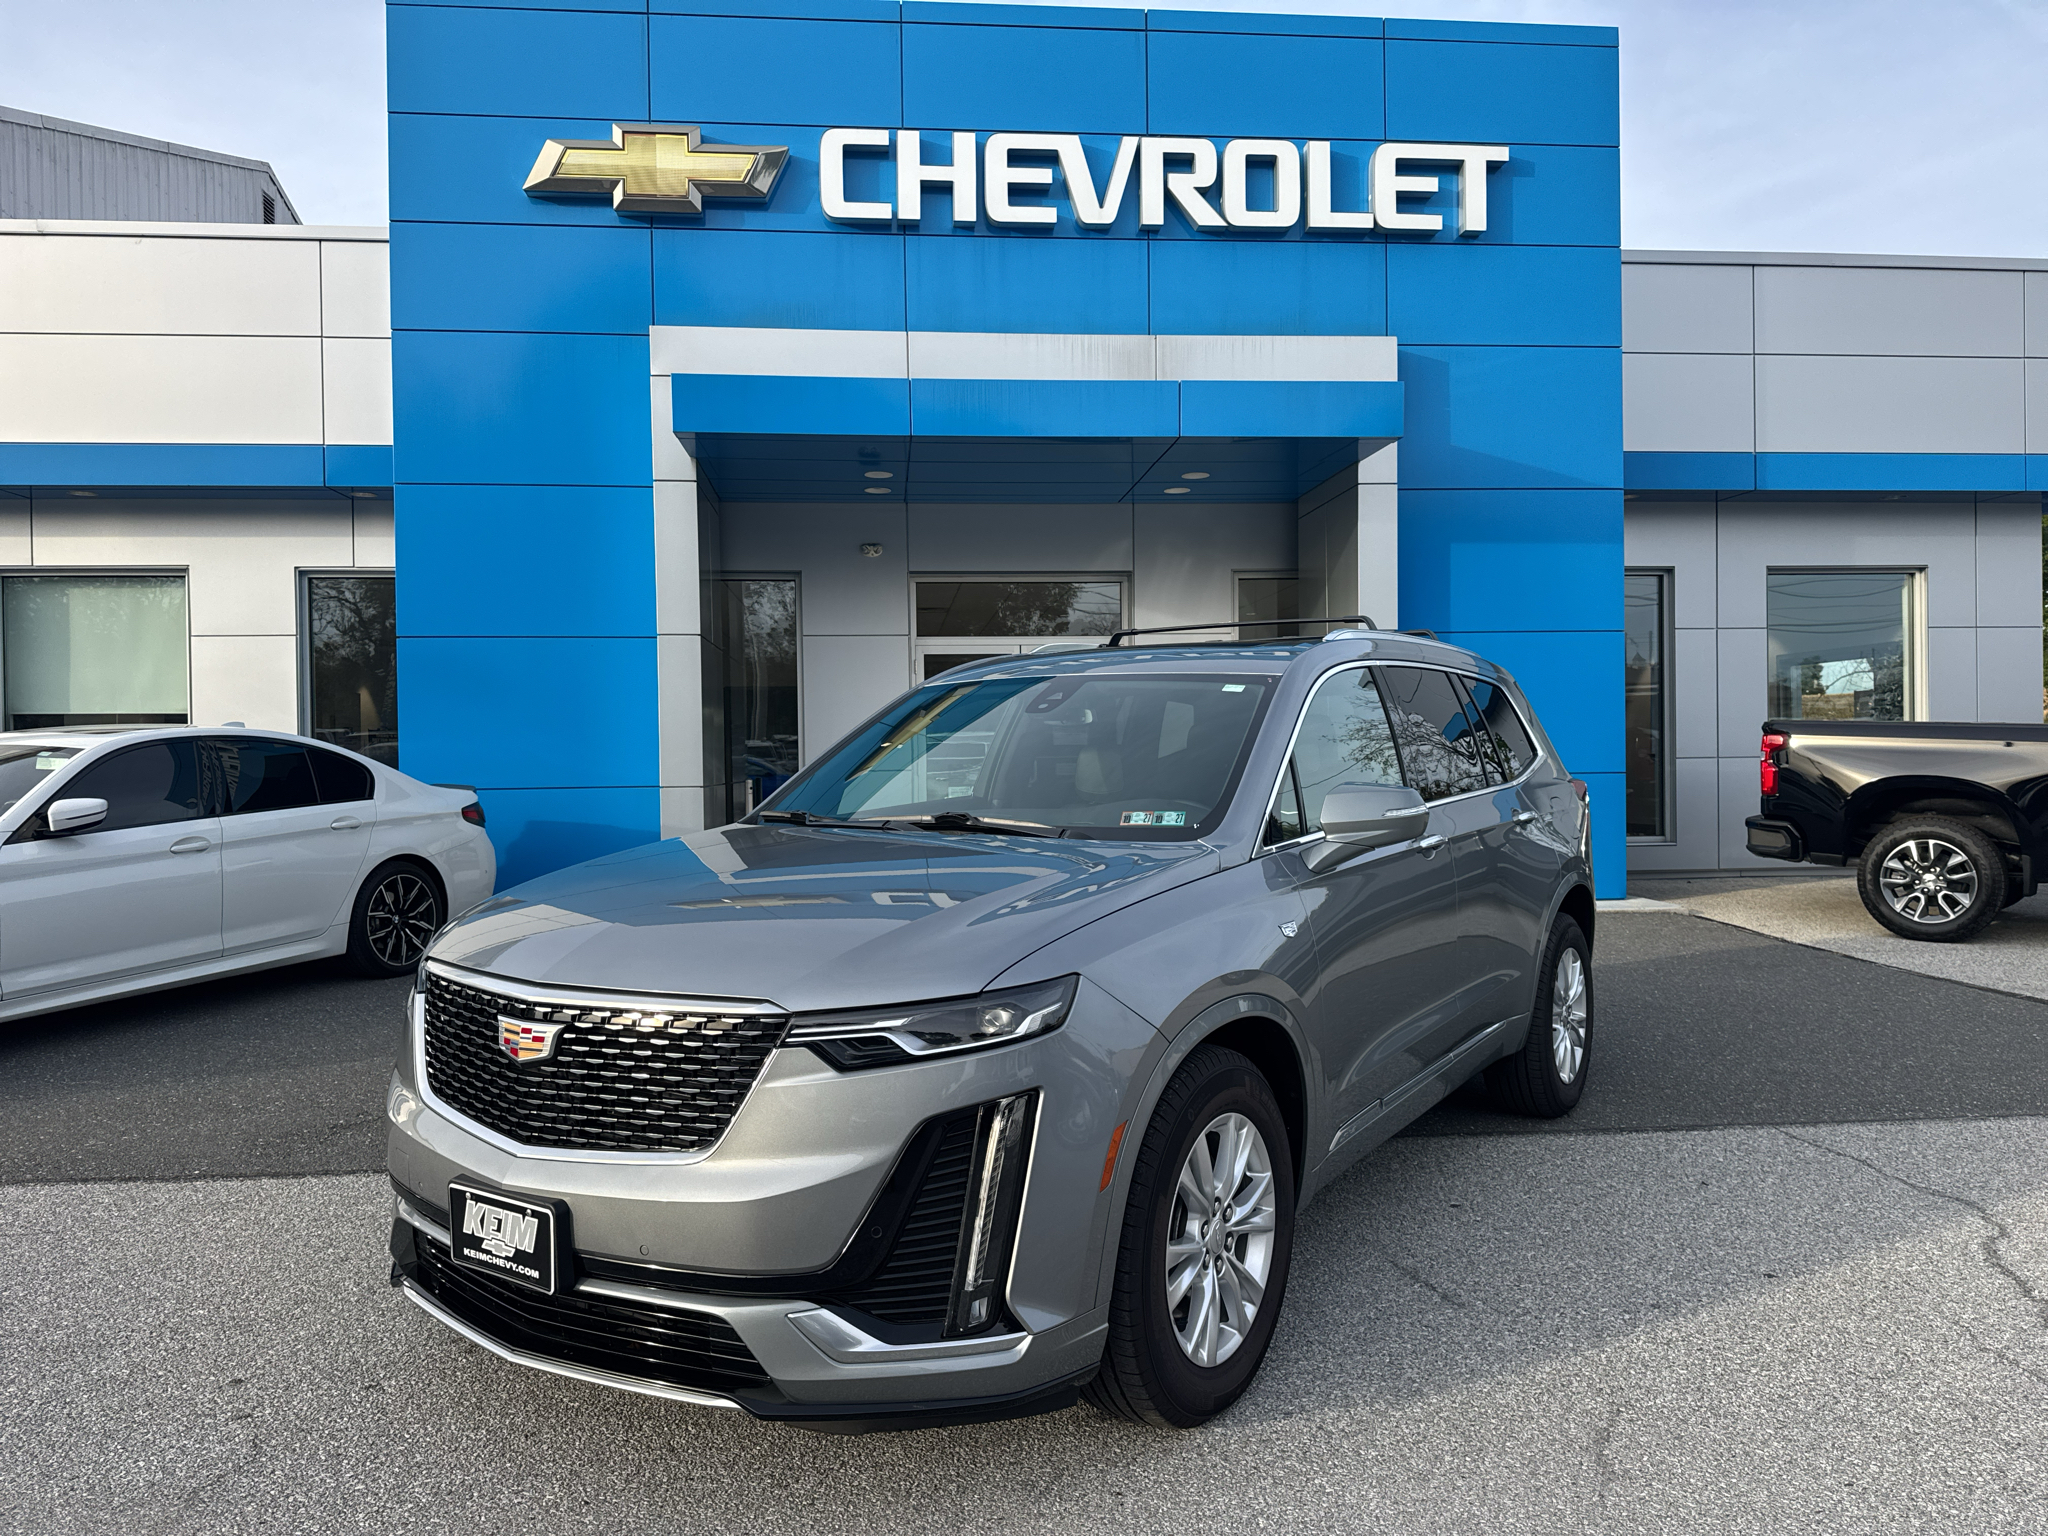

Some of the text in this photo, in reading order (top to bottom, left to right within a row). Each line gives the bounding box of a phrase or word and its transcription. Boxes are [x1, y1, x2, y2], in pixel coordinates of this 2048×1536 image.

[819, 128, 1510, 236] CHEVROLET
[463, 1200, 538, 1253] KEIM
[463, 1247, 539, 1279] KEIMCHEVY.COM
